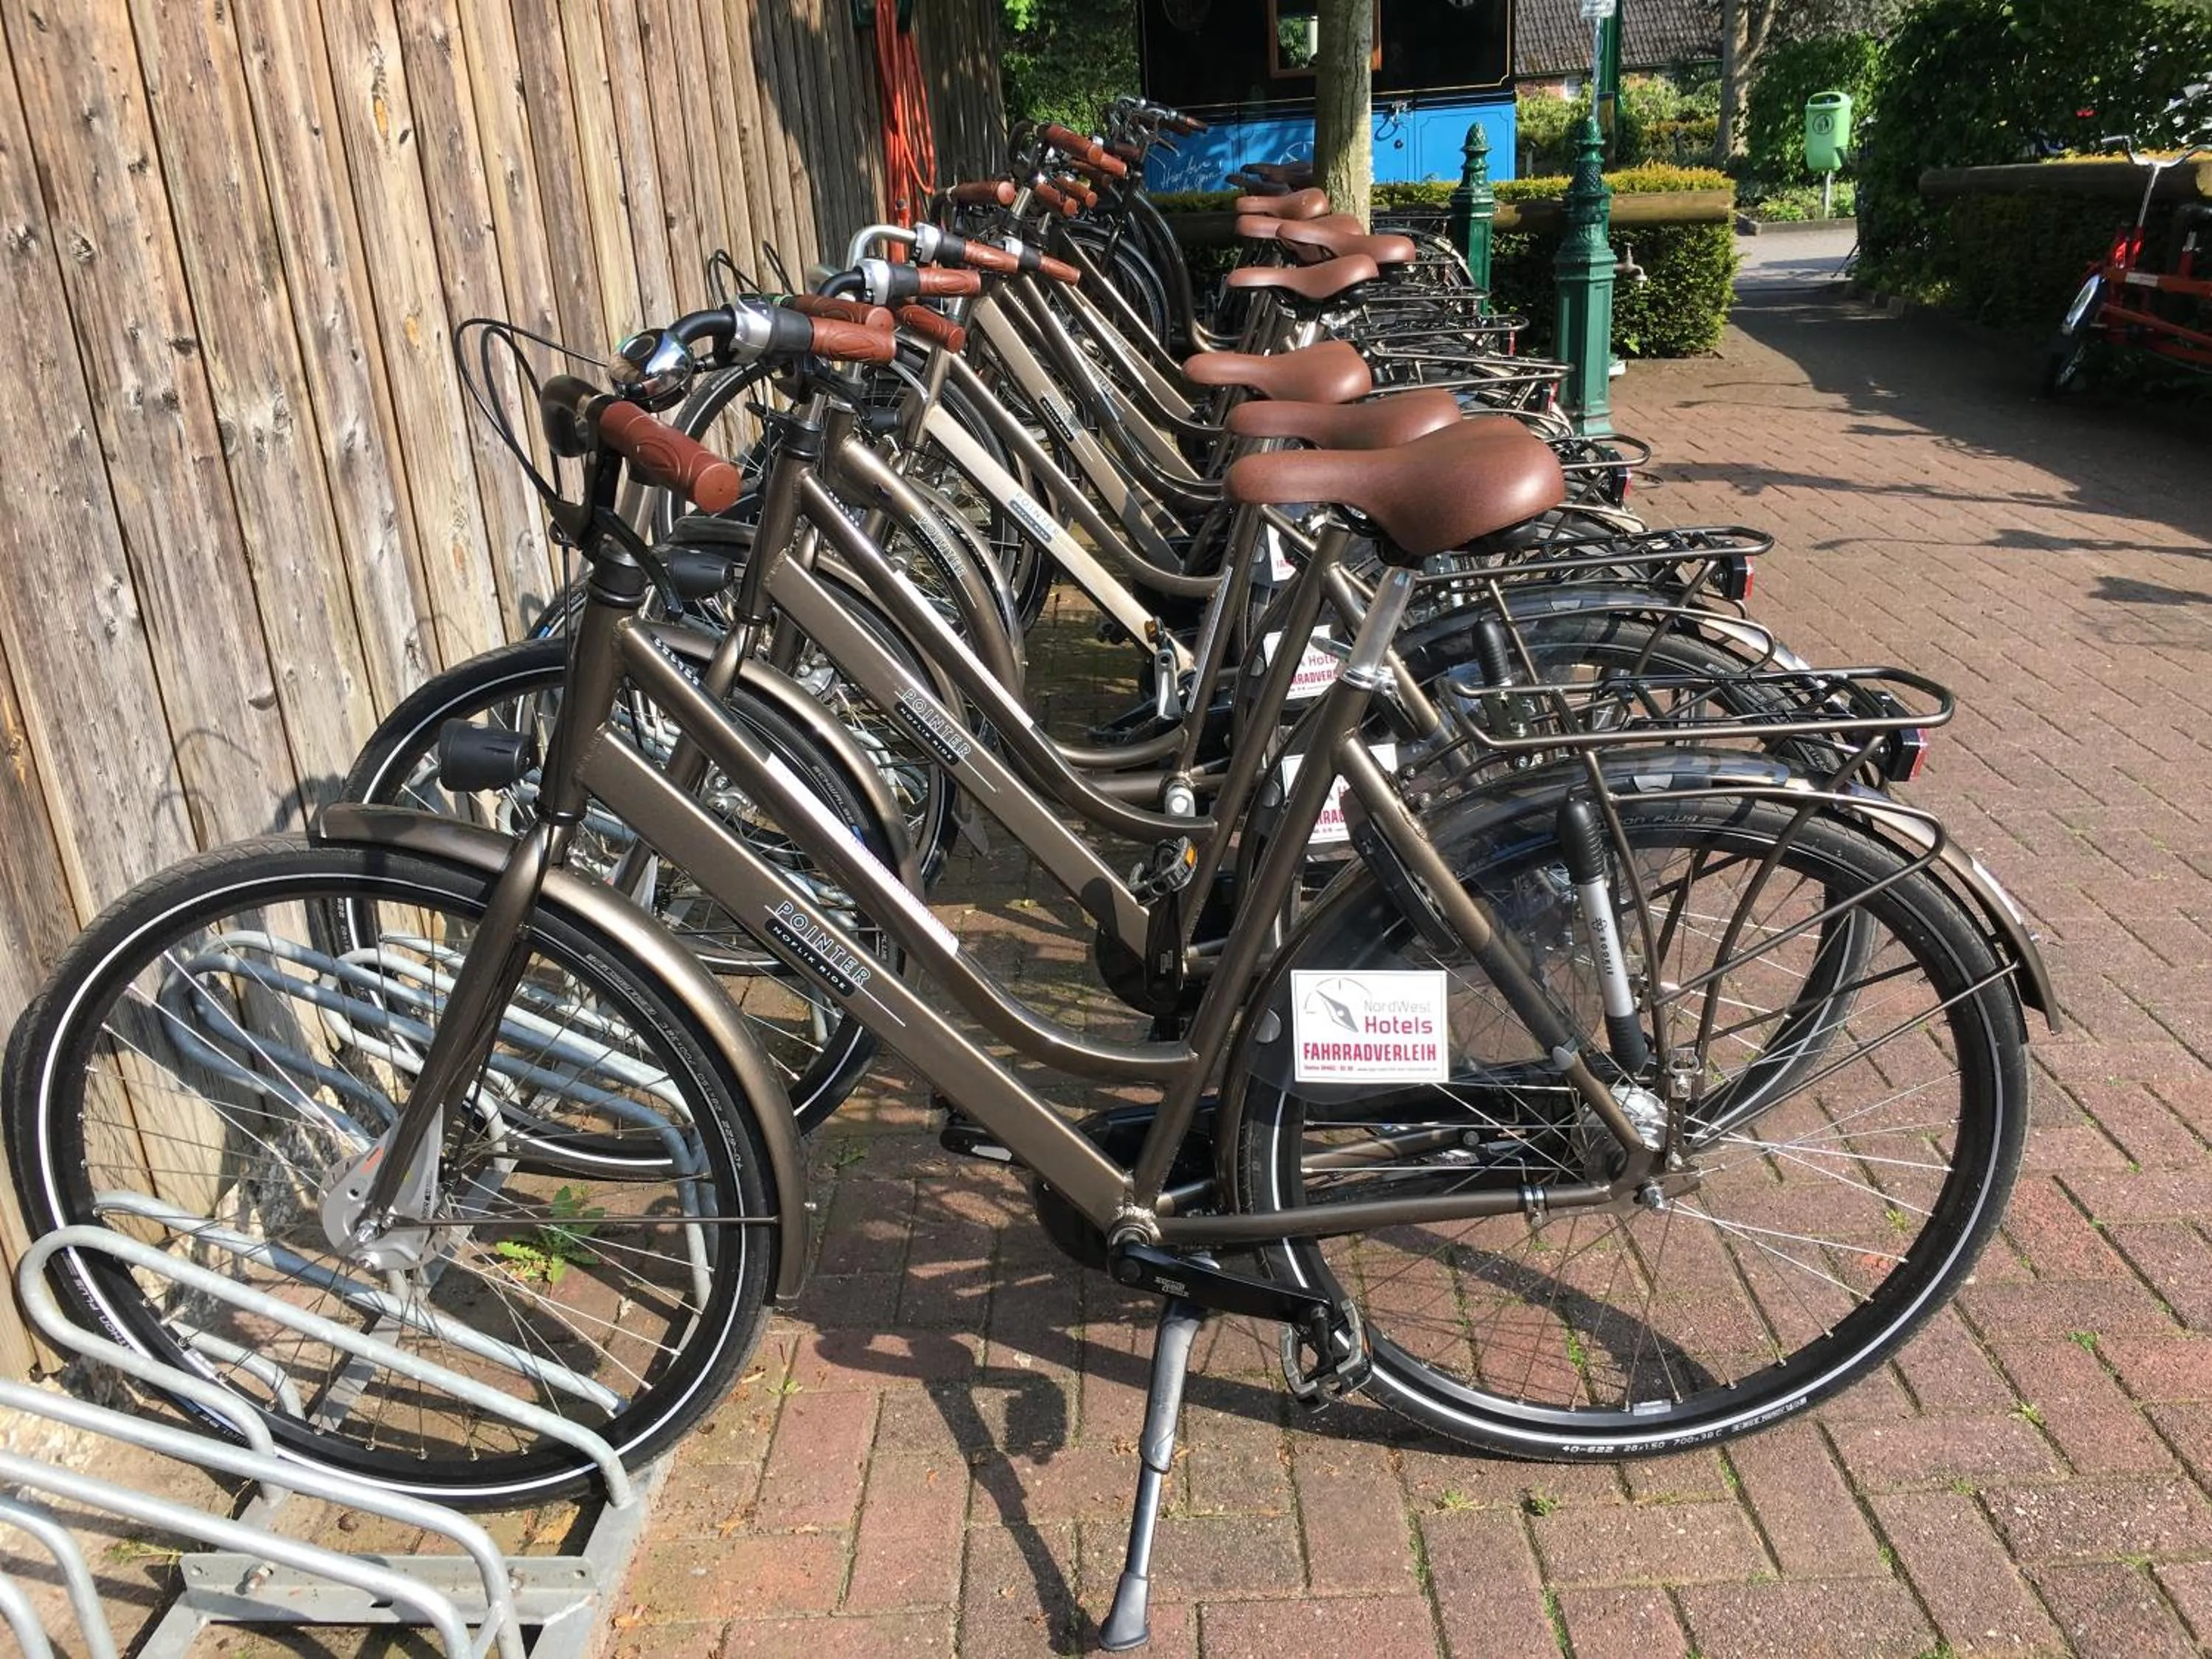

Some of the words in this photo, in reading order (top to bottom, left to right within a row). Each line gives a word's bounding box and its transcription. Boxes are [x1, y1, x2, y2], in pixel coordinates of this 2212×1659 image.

[902, 688, 971, 759] POINTER
[776, 901, 871, 986] POINTER
[818, 966, 846, 990] RIDE
[1364, 1000, 1431, 1013] NordWest
[1365, 1016, 1433, 1034] Hotels
[1304, 1042, 1437, 1062] FAHRRADVERLEIH
[1561, 1444, 1615, 1454] 40-622
